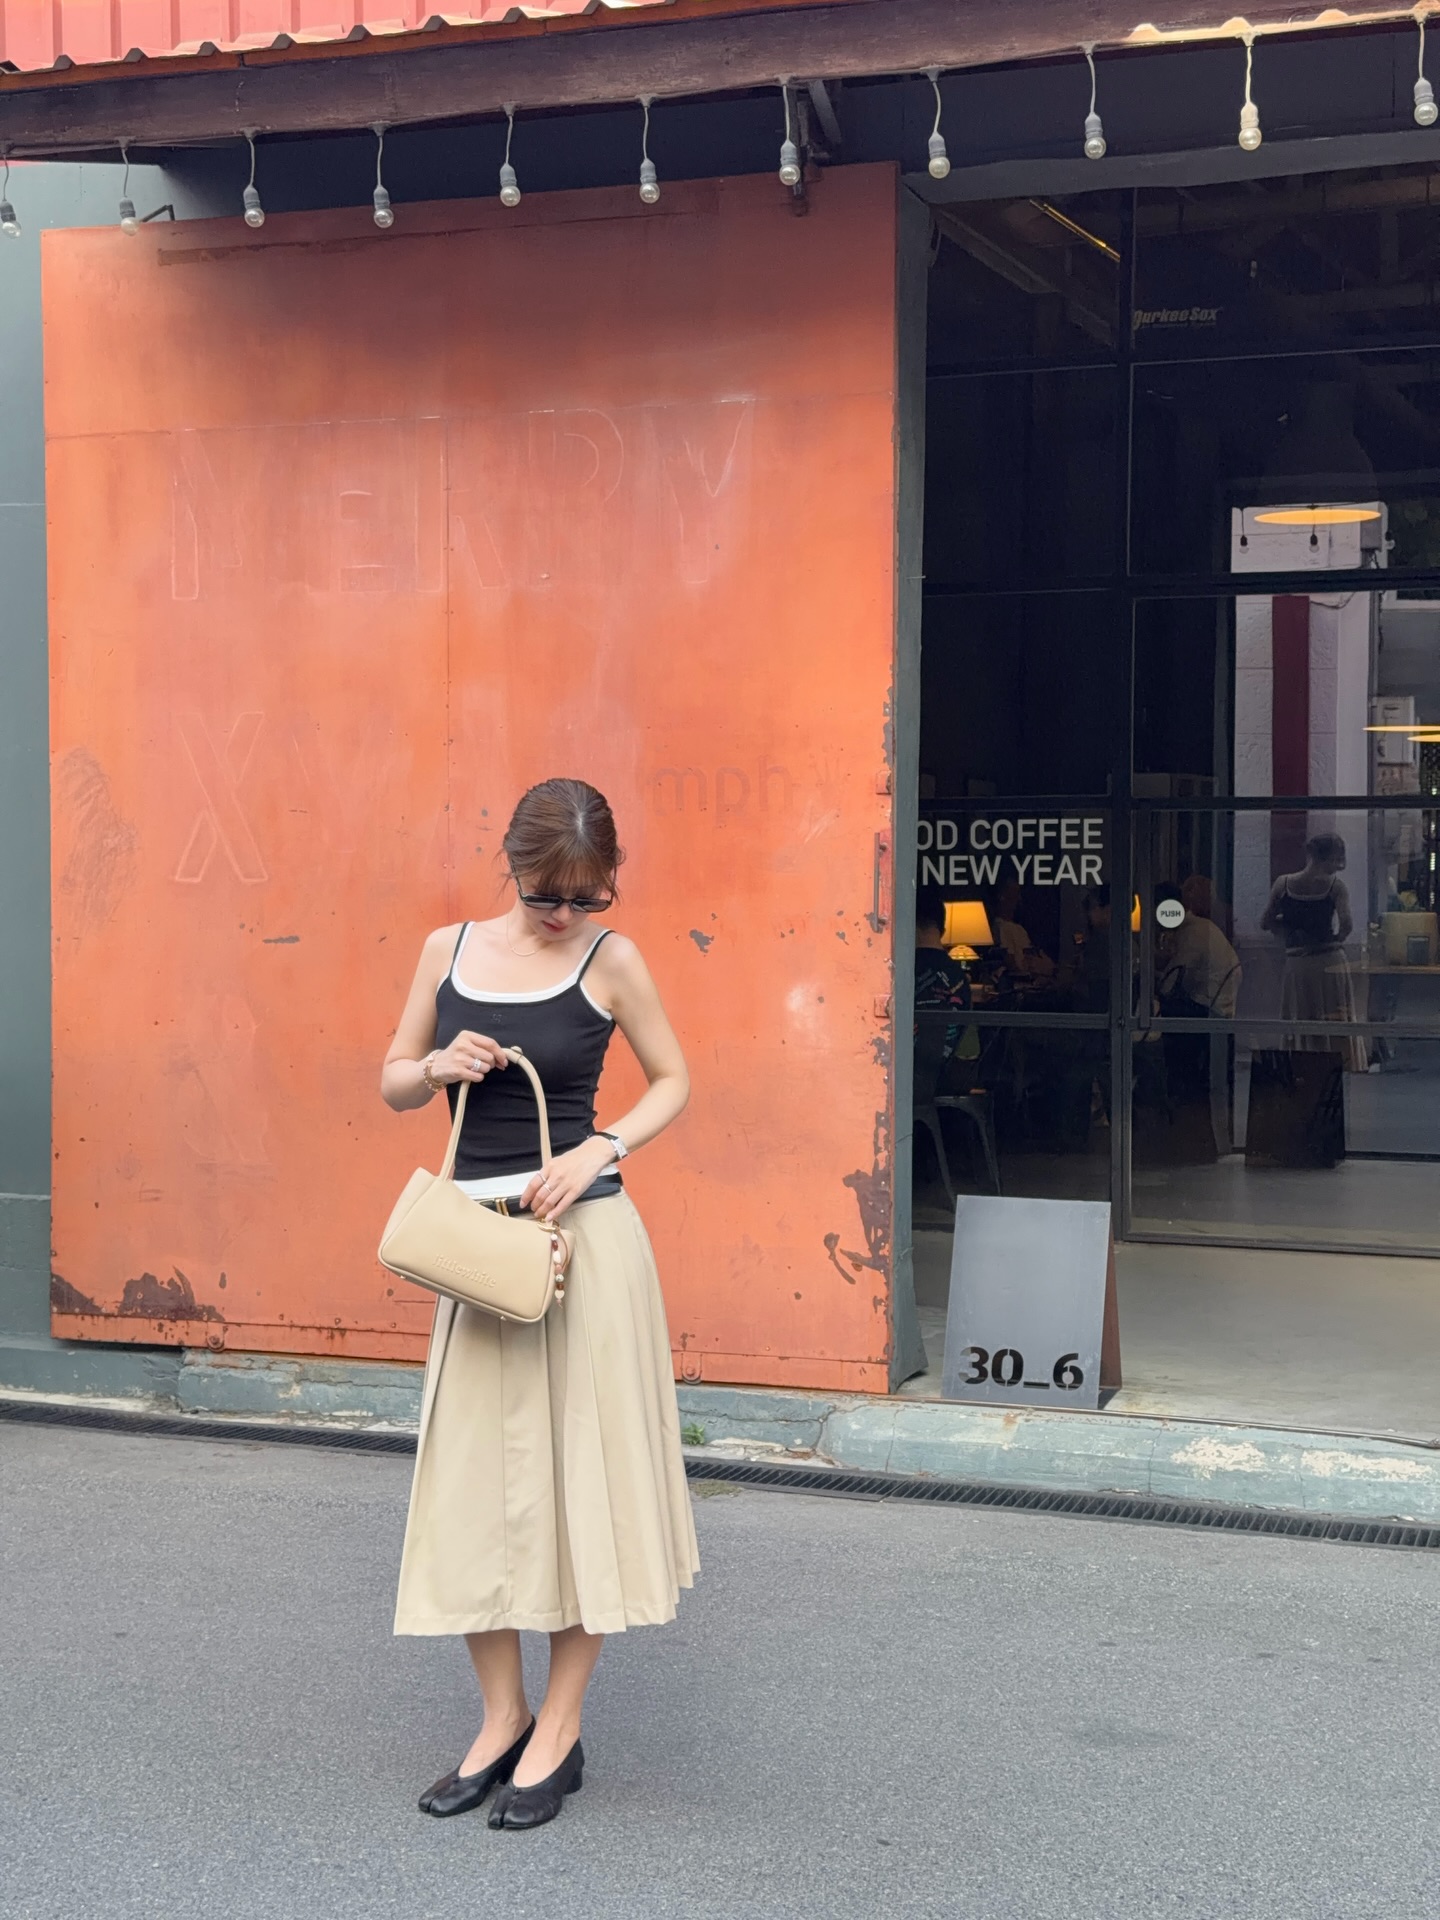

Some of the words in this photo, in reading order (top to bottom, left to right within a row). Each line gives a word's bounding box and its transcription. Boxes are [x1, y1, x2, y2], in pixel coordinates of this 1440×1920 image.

[970, 818, 1104, 850] COFFEE
[922, 855, 1002, 886] NEW
[1011, 854, 1104, 886] YEAR
[1160, 910, 1182, 918] PUSH
[958, 1346, 1084, 1391] 30_6
